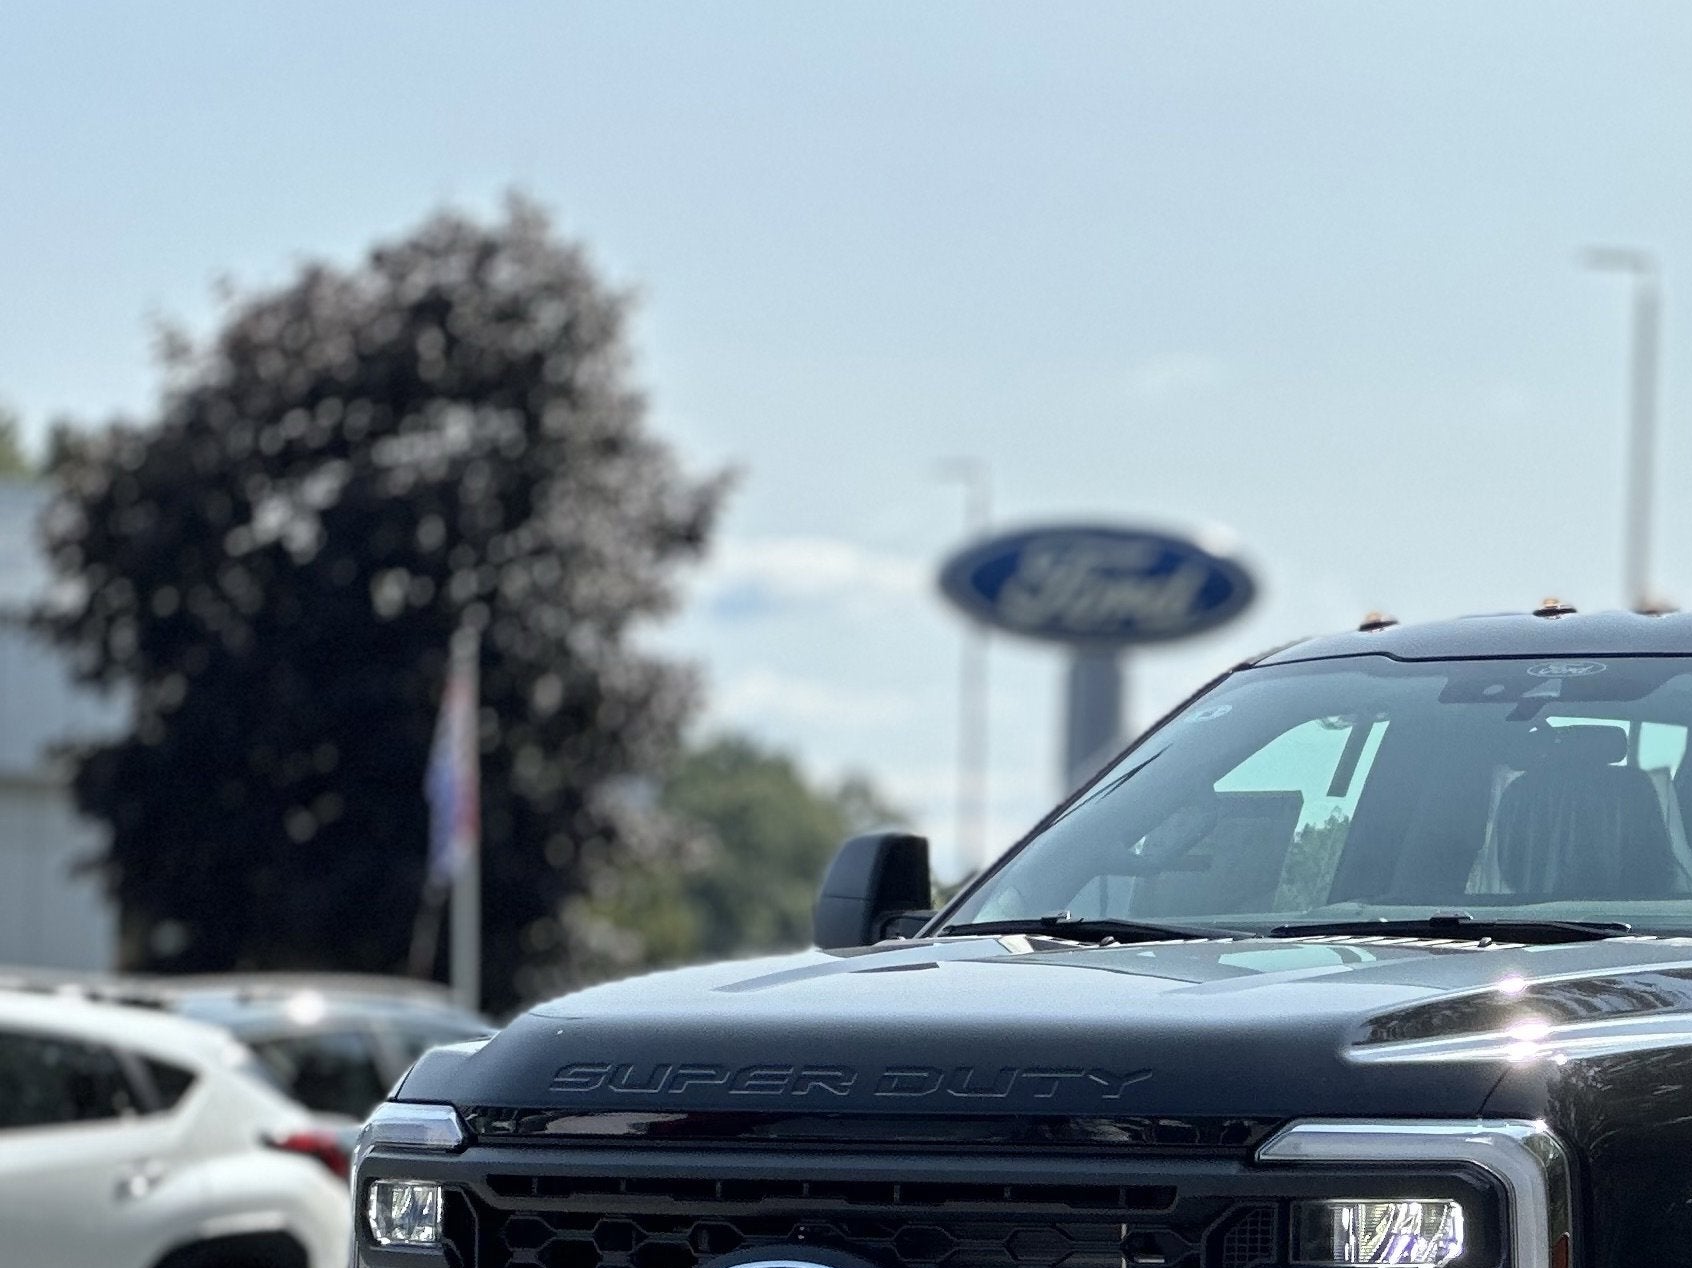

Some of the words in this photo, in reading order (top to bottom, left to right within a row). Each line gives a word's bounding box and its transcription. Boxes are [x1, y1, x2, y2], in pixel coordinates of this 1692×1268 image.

[997, 538, 1206, 632] Ford
[550, 1063, 858, 1096] SUPER
[873, 1066, 1152, 1099] DUTY
